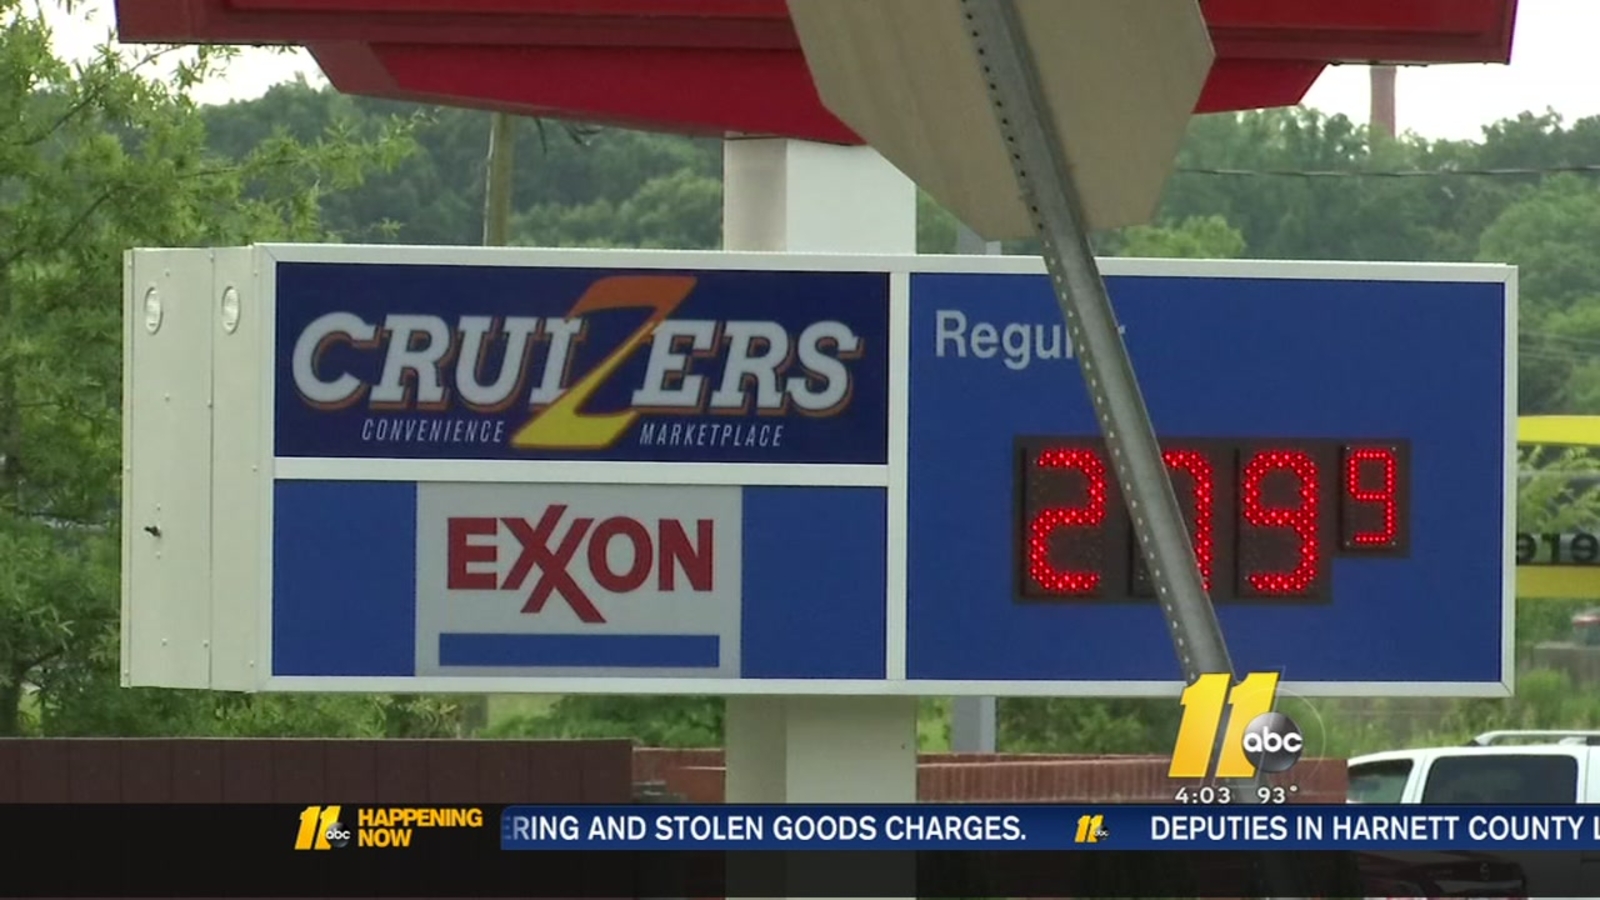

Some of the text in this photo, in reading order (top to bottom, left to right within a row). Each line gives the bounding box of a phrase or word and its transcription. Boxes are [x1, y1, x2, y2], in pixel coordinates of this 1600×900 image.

[292, 275, 864, 449] CRUIZERS
[361, 418, 784, 448] CONVENIENCE MARKETPLACE
[447, 504, 714, 623] EXXON
